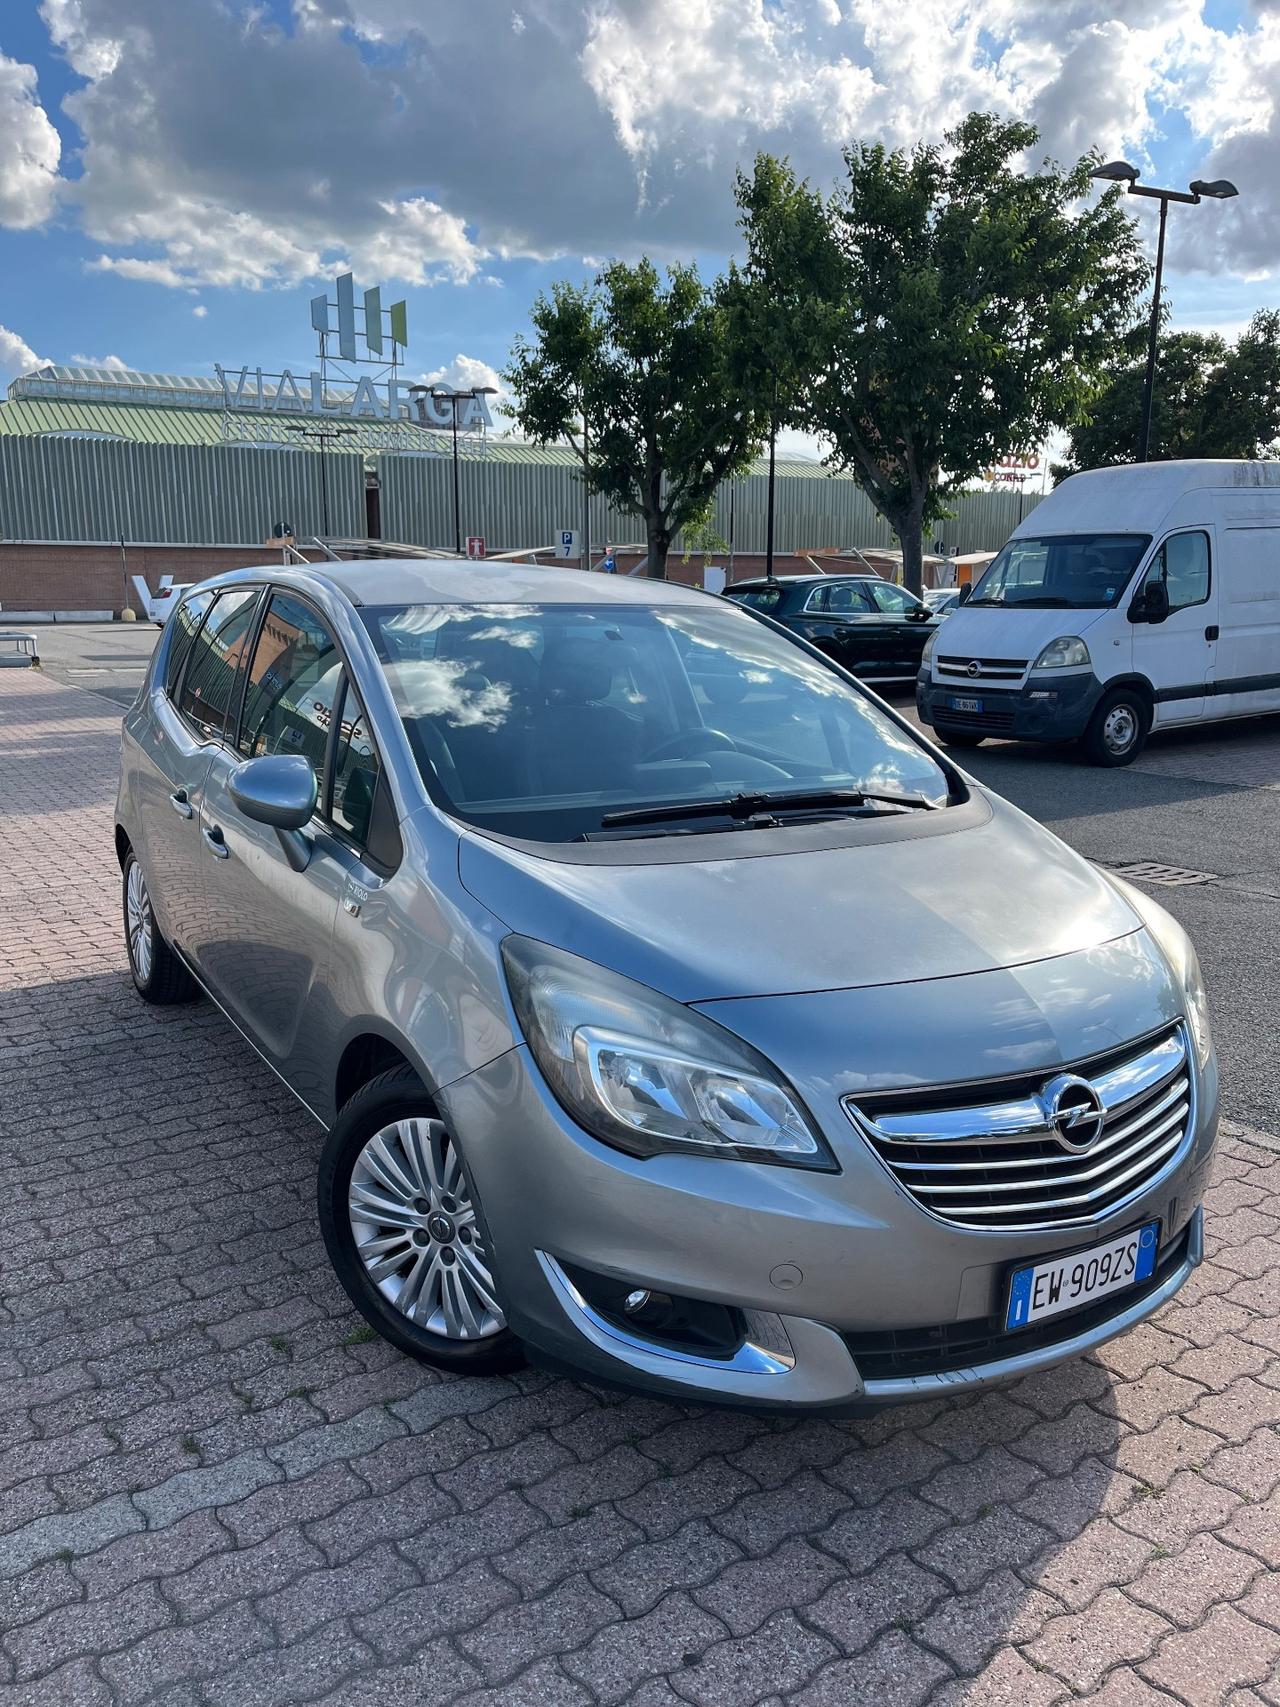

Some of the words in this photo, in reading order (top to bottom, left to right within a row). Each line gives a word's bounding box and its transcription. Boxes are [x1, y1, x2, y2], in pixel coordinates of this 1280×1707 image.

[214, 363, 493, 427] VIALARGA
[563, 532, 571, 543] P
[564, 546, 571, 556] 7
[1032, 1268, 1064, 1310] EW
[1070, 1242, 1137, 1298] 909ZS
[1015, 1299, 1022, 1321] I
